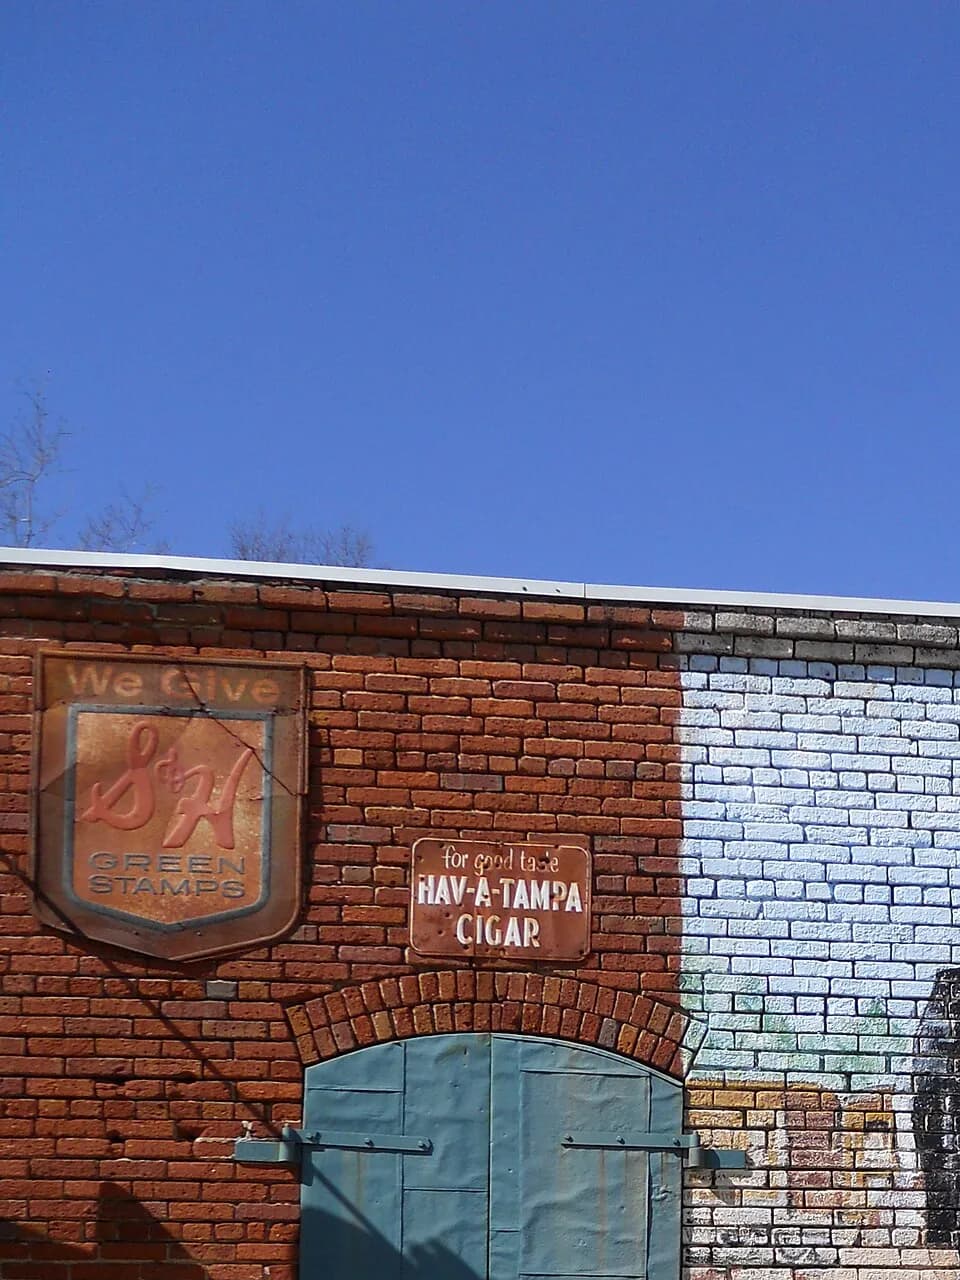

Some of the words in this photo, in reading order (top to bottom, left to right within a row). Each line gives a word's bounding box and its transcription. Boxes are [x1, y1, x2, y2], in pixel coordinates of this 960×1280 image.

[66, 664, 144, 697] We
[160, 667, 281, 701] Give
[88, 852, 246, 875] GREEN
[442, 845, 469, 869] for
[474, 848, 513, 876] good
[89, 875, 246, 899] STAMPS
[418, 874, 583, 913] HAV-A-TAMPA
[456, 913, 540, 948] CIGAR
